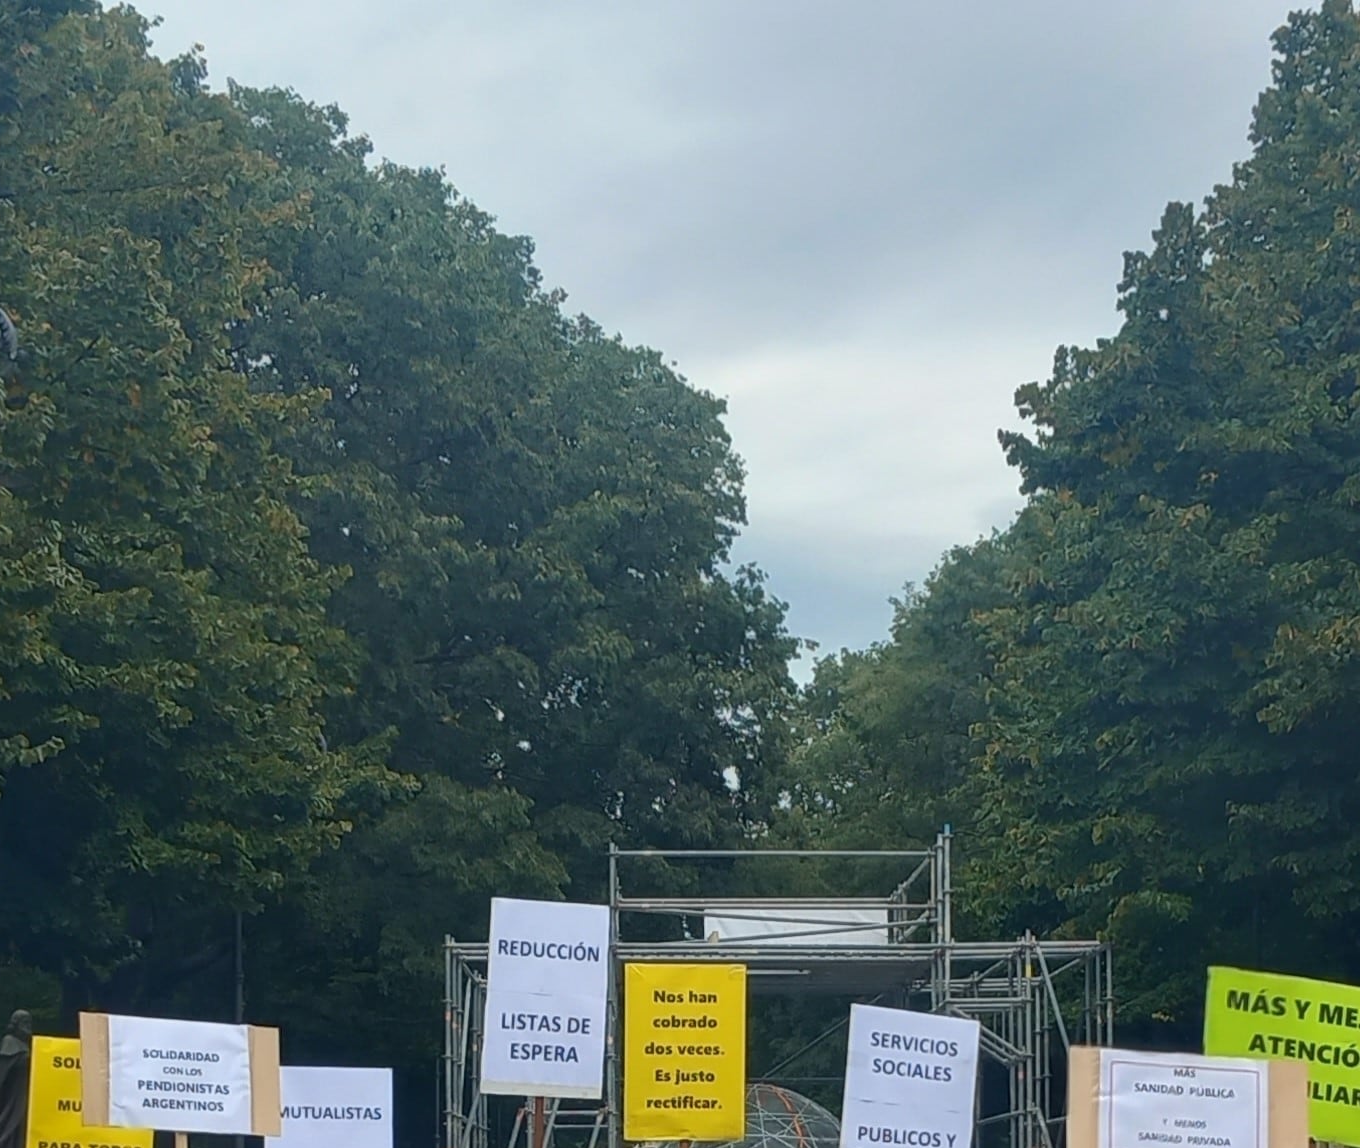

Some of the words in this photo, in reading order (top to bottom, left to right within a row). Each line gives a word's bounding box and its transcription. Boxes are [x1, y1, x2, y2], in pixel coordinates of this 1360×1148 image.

[498, 939, 600, 963] REDUCCIÓN
[653, 991, 684, 1004] Nos
[688, 991, 717, 1004] han
[1226, 989, 1287, 1016] MÁS
[1295, 999, 1311, 1020] Y
[501, 1013, 561, 1033] LISTAS
[567, 1017, 591, 1035] DE
[653, 1015, 717, 1028] cobrado
[644, 1042, 673, 1055] dos
[677, 1044, 725, 1055] veces.
[871, 1032, 958, 1057] SERVICIOS
[142, 1049, 220, 1063] SOLIDARIDAD
[510, 1043, 579, 1063] ESPERA
[53, 1056, 81, 1069] SOL
[872, 1058, 952, 1082] SOCIALES
[163, 1066, 183, 1075] CON
[185, 1067, 202, 1076] LOS
[655, 1069, 671, 1082] Es
[675, 1069, 715, 1085] justo
[1174, 1066, 1196, 1078] MÁS
[138, 1079, 230, 1095] PENDIONISTAS
[1134, 1082, 1184, 1096] SANIDAD
[1189, 1084, 1235, 1098] PÚBLICA
[58, 1099, 82, 1112] MU
[142, 1098, 224, 1112] ARGENTINOS
[646, 1095, 723, 1110] rectificar.
[280, 1105, 382, 1120] MUTUALISTAS
[1174, 1119, 1207, 1129] MENOS
[858, 1126, 941, 1148] PUBLICOS
[946, 1134, 957, 1148] Y
[1138, 1132, 1182, 1144] SANIDAD
[1187, 1135, 1231, 1147] PRIVADA
